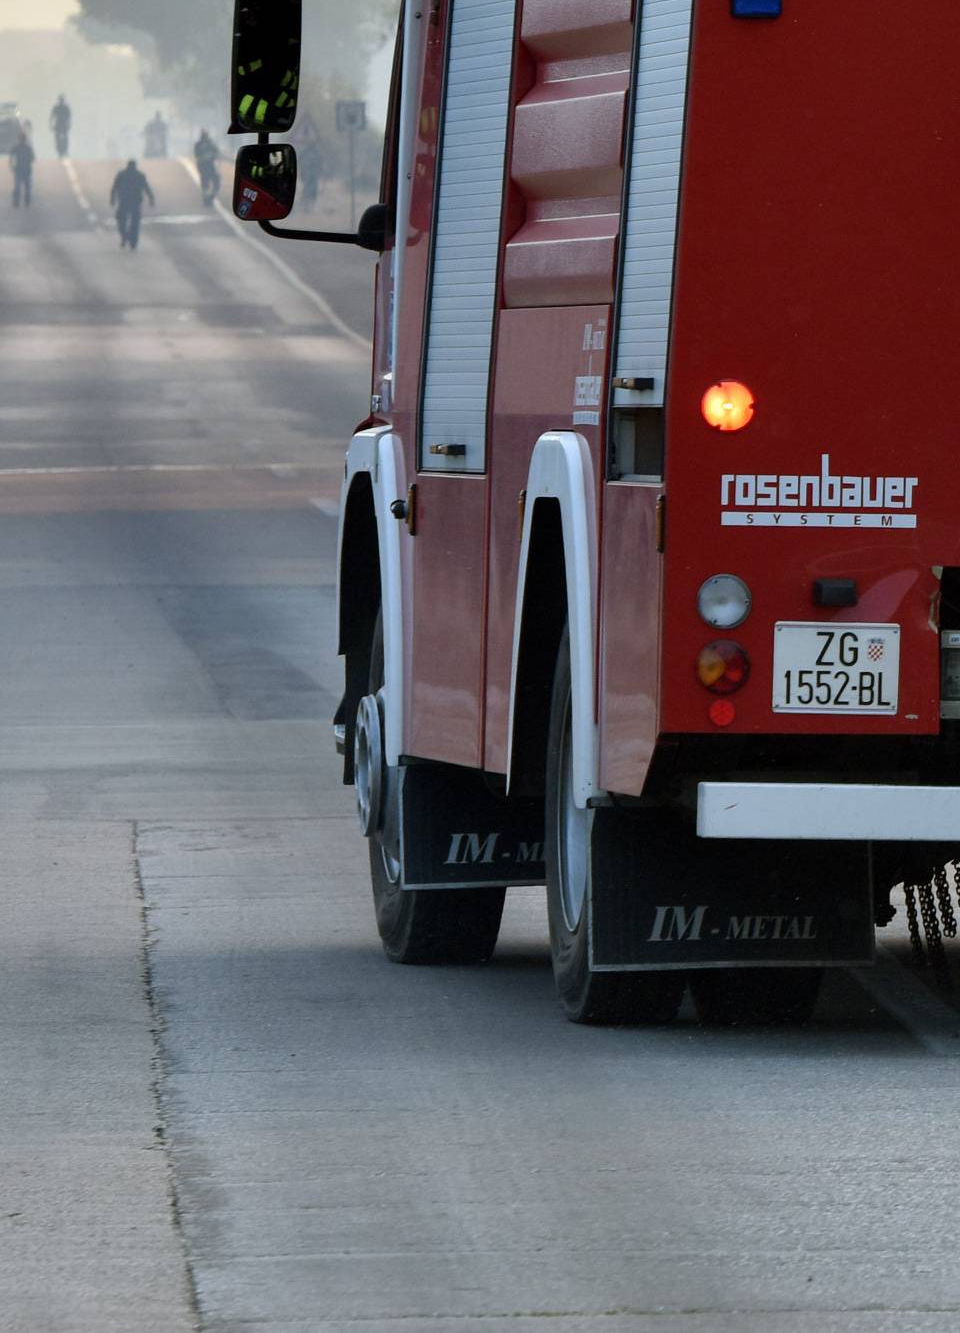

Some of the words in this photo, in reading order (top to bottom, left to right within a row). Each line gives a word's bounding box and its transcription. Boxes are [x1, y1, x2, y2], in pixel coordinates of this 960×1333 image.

[720, 453, 919, 509] rosenbauer
[746, 513, 893, 527] SYSTEM
[815, 631, 859, 667] ZG
[784, 670, 891, 707] 1552-BL
[443, 832, 501, 865] IM
[647, 905, 709, 942] IM
[724, 915, 818, 941] METAL
